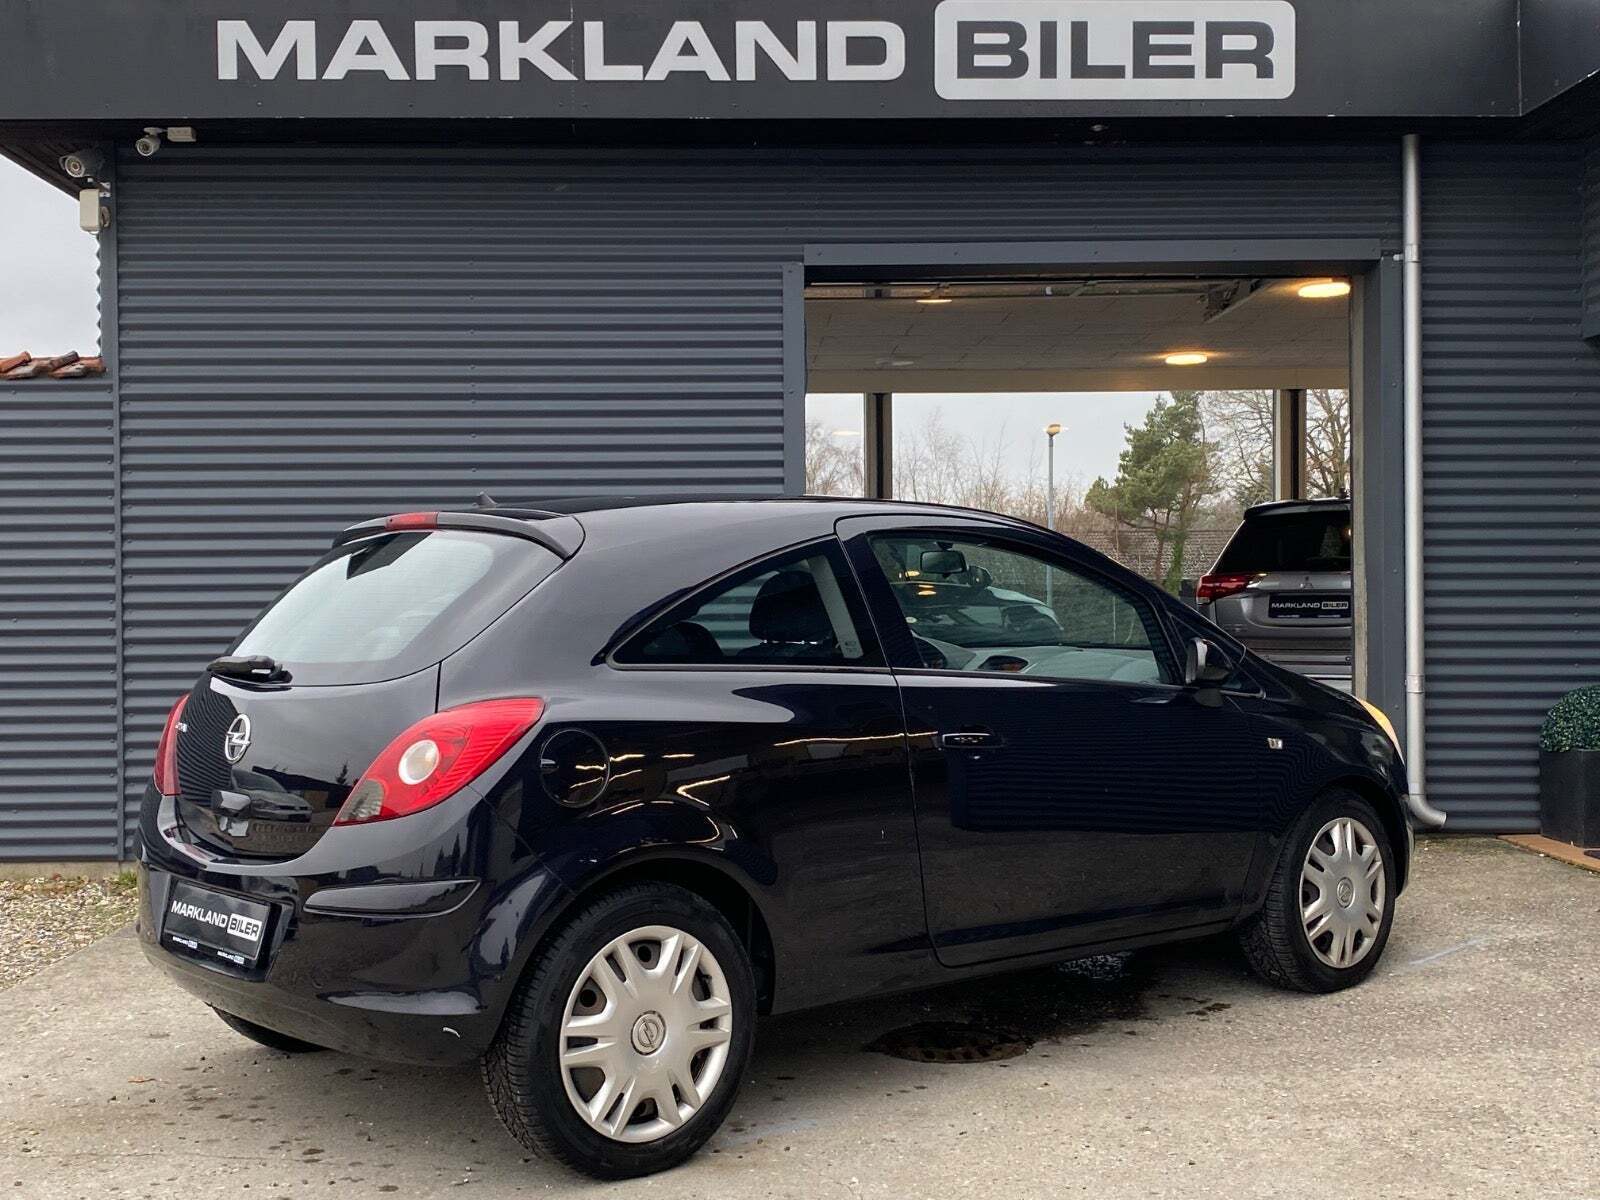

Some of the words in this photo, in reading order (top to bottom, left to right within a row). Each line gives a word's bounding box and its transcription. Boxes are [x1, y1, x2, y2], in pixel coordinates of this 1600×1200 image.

[217, 20, 906, 81] MARKLAND
[956, 19, 1275, 80] BILER
[171, 900, 228, 928] MARKLAND
[229, 916, 260, 938] BILER
